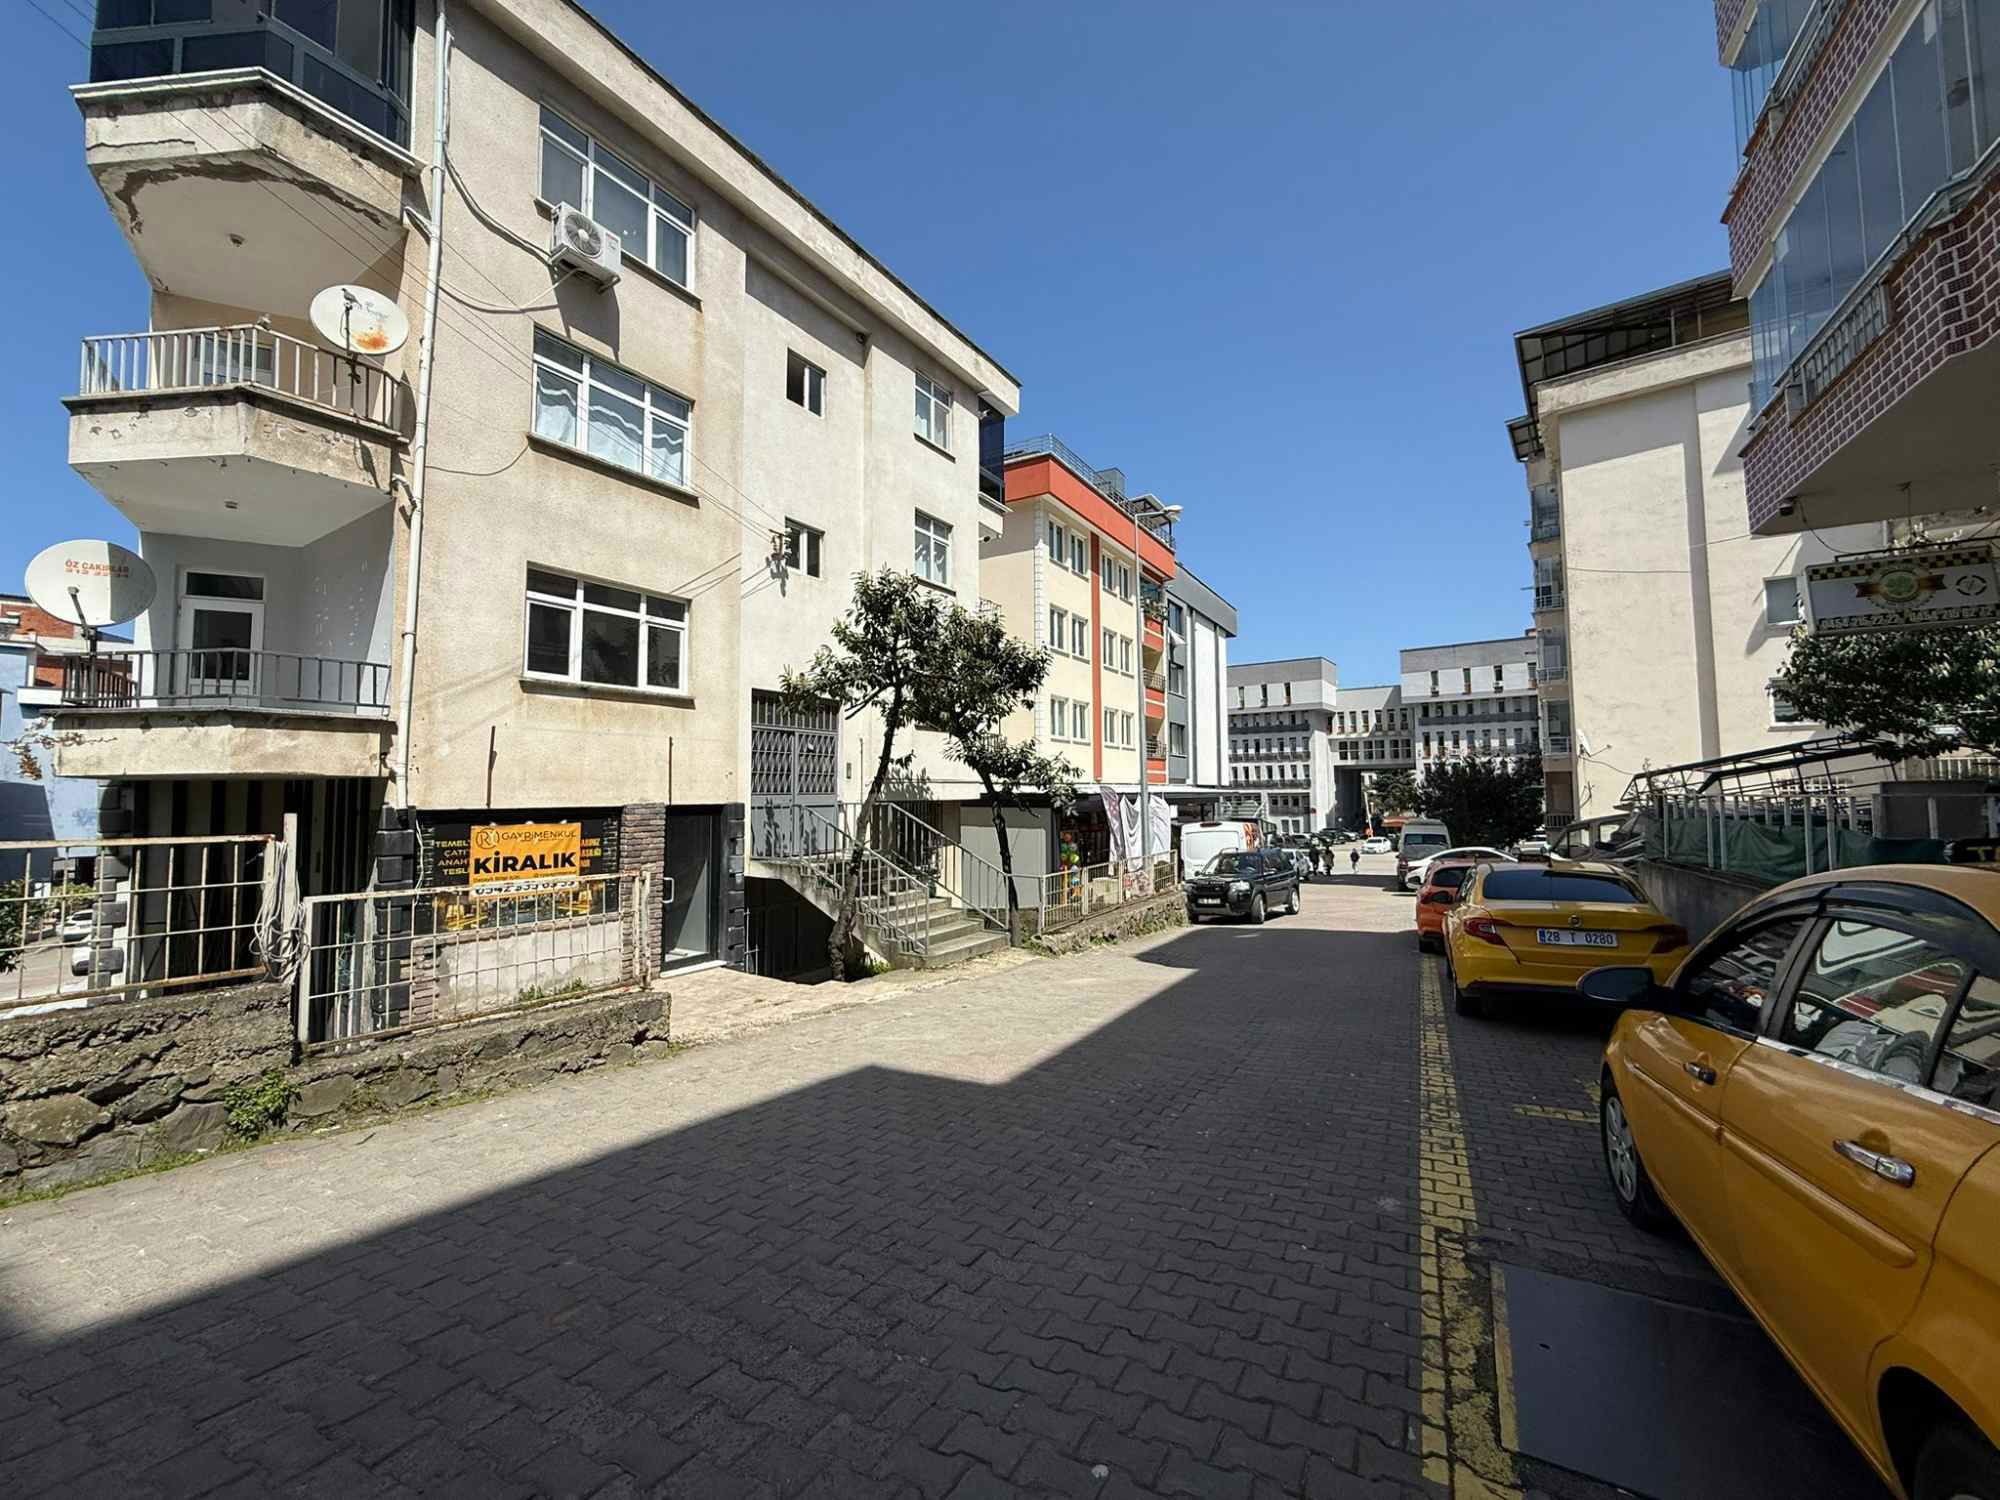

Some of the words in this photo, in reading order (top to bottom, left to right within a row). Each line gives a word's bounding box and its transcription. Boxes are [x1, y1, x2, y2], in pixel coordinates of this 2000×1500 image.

[473, 850, 577, 875] KİRALIK
[1546, 930, 1561, 942] 28
[1568, 931, 1576, 943] T
[1584, 932, 1613, 945] 0280
